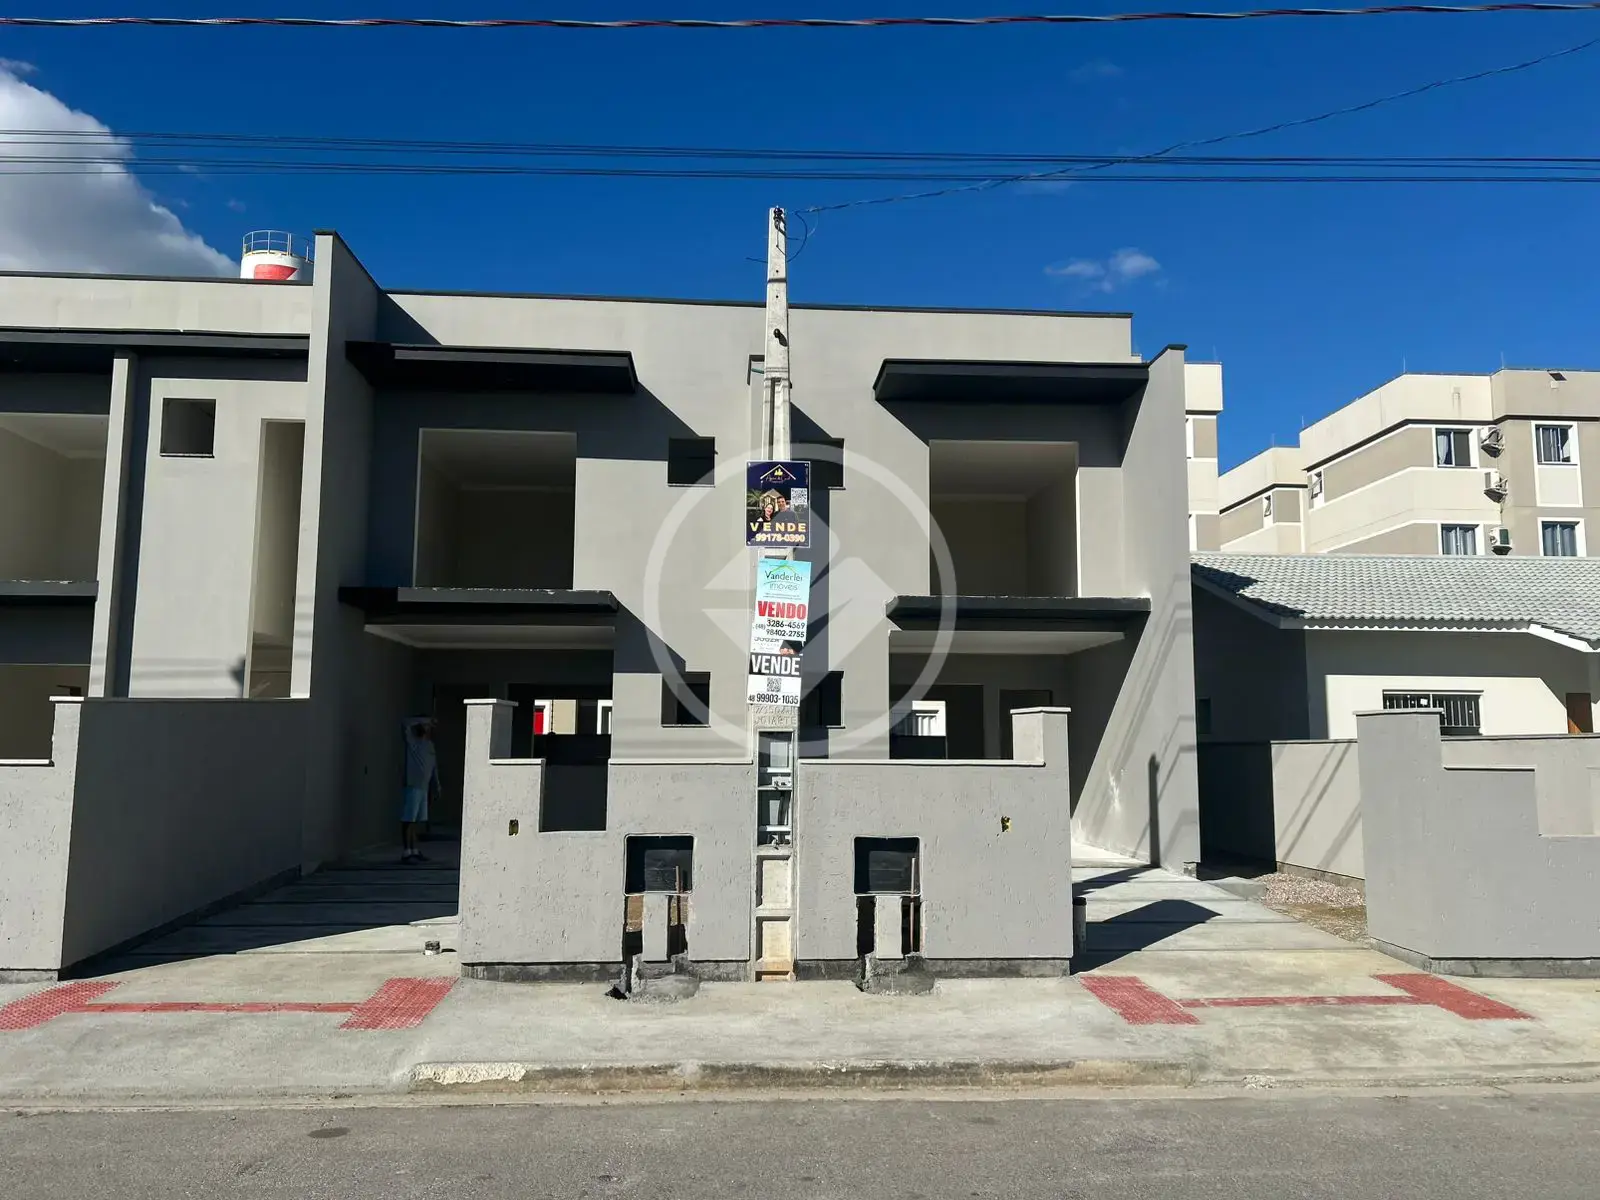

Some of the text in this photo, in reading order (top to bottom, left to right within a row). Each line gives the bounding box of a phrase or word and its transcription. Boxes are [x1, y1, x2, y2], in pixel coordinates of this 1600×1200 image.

[750, 522, 806, 532] VENDE
[765, 570, 803, 582] Vanderlei
[757, 600, 807, 620] VENDO
[766, 619, 806, 630] 3286-4569
[766, 629, 805, 638] 98402-2755
[751, 654, 801, 676] VENDE
[748, 693, 799, 705] 48 99903-1035
